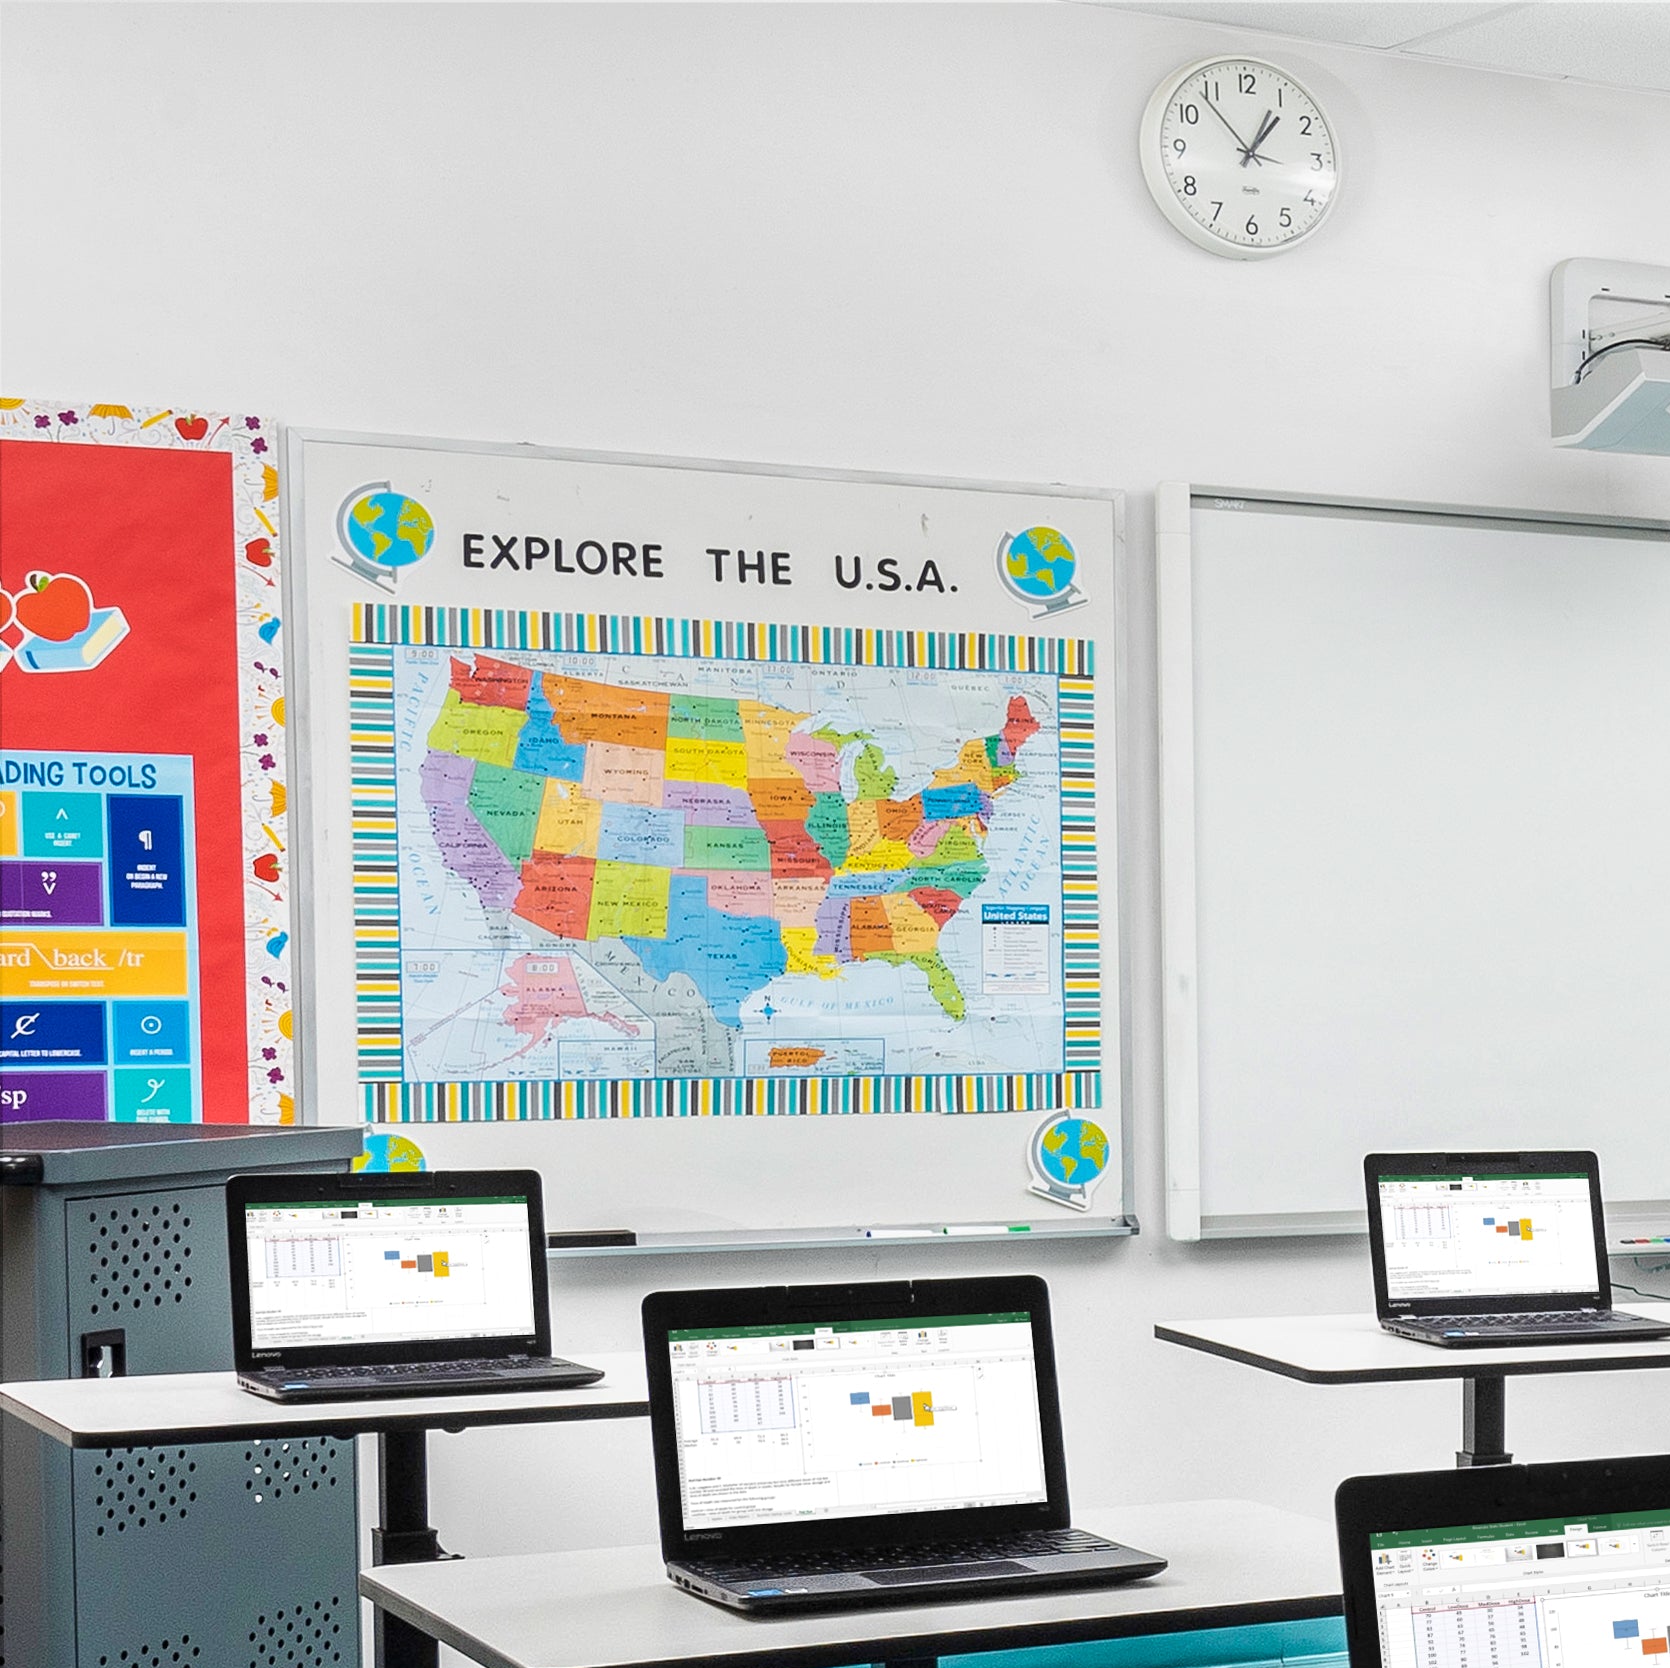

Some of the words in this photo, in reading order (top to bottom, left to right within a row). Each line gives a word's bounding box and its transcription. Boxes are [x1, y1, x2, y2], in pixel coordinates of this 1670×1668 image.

[1204, 81, 1219, 101] 11
[1239, 74, 1256, 94] 12
[1278, 88, 1282, 108] 1
[1180, 103, 1199, 124] 10
[1299, 115, 1312, 135] 2
[1173, 138, 1186, 159] 9
[1310, 153, 1323, 171] 3
[1184, 176, 1196, 195] 8
[1303, 189, 1315, 206] 4
[1211, 201, 1223, 221] 7
[1279, 208, 1291, 227] 5
[1246, 214, 1258, 235] 6
[462, 532, 664, 579] EXPLORE
[705, 547, 793, 587] THE
[834, 554, 959, 594] U.S.A.
[401, 672, 429, 752] PACIFIC
[0, 760, 64, 786] DING
[72, 762, 157, 789] TOOLS
[998, 814, 1040, 898] ATLANTIC
[1019, 837, 1050, 892] OCEAN
[408, 853, 441, 915] OCEAN
[984, 911, 1017, 921] United
[1018, 910, 1047, 921] States
[53, 948, 107, 967] back
[910, 955, 948, 972] FLORIDA
[684, 1533, 722, 1541] Lenovo
